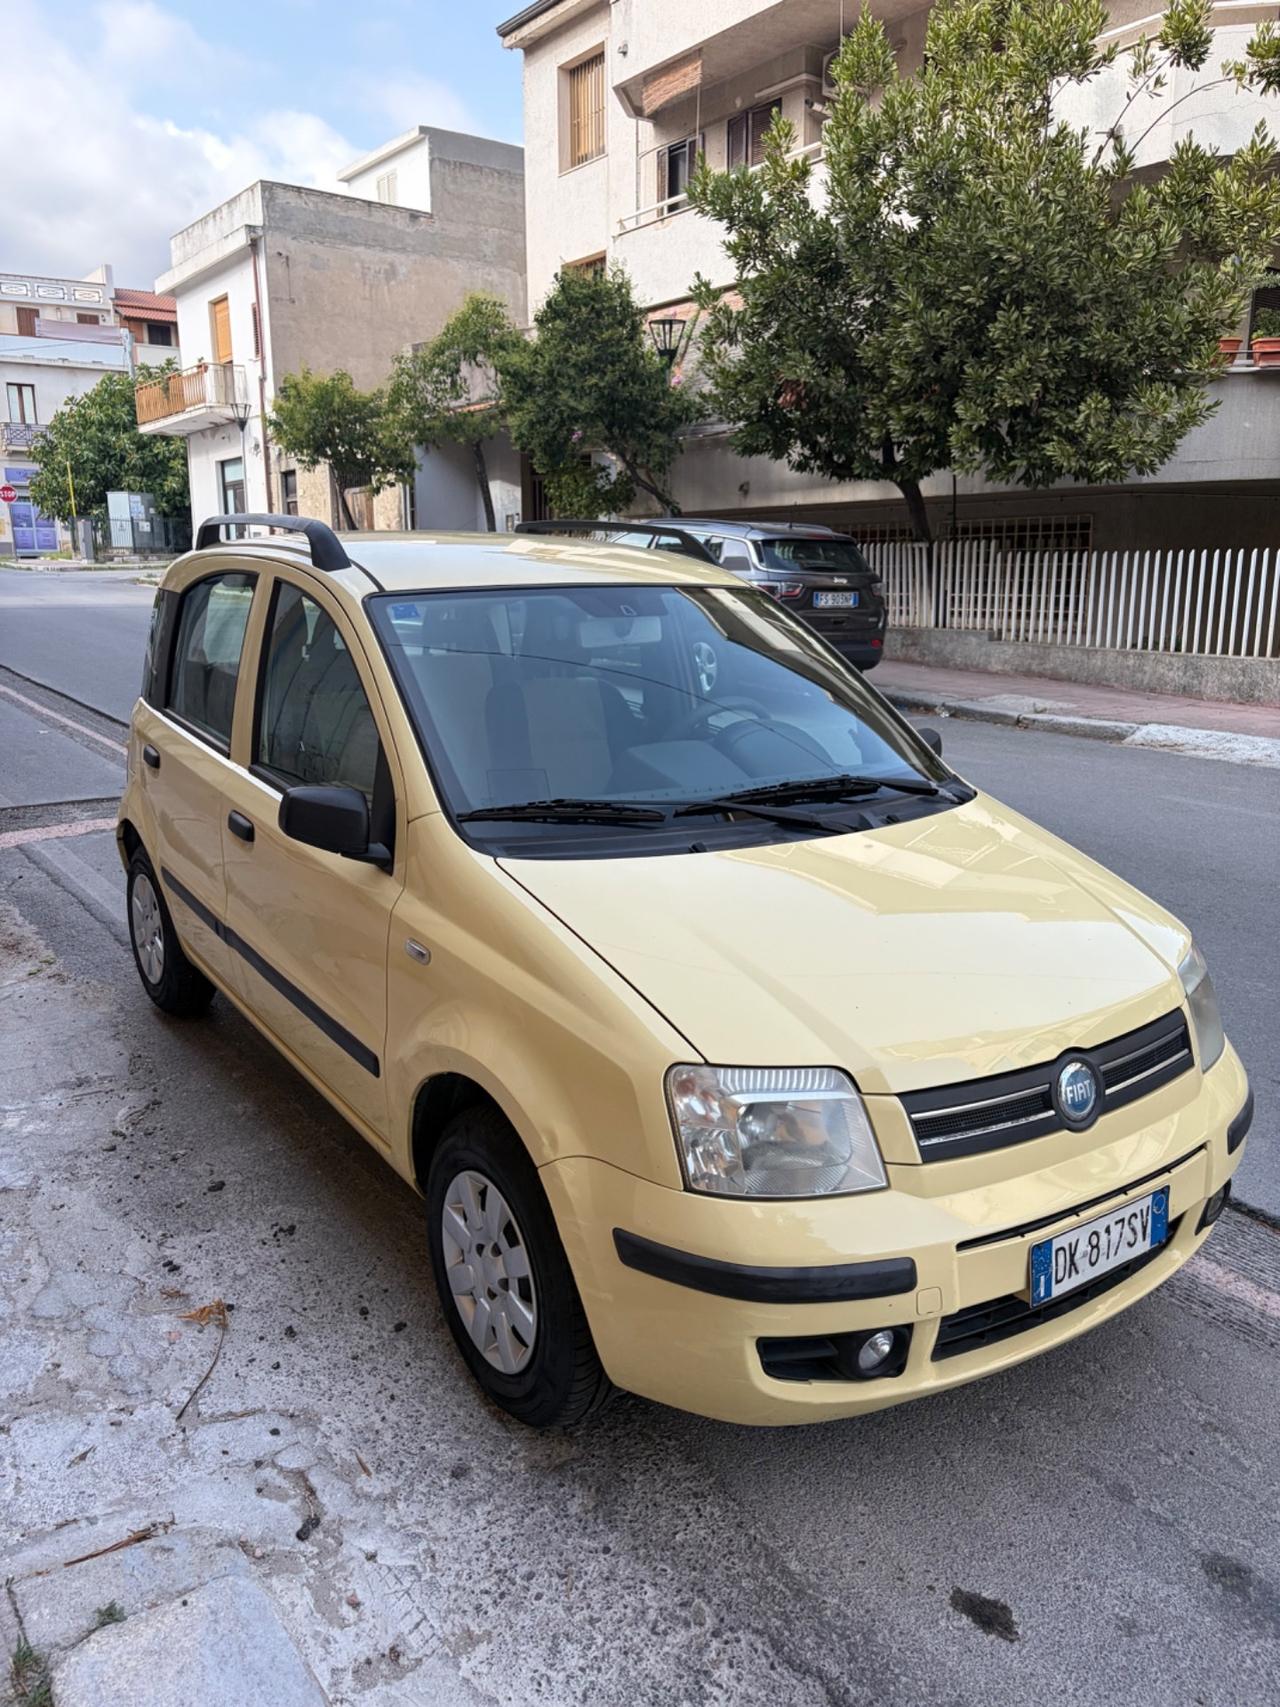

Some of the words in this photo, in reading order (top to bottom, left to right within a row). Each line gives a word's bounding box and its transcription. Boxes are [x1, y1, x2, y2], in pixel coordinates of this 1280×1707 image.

[0, 490, 15, 498] STOP
[833, 576, 848, 584] Jeep
[820, 593, 829, 605] FS
[1066, 1080, 1091, 1105] FIAT
[1054, 1237, 1080, 1284] DK
[1088, 1205, 1150, 1267] 817SV
